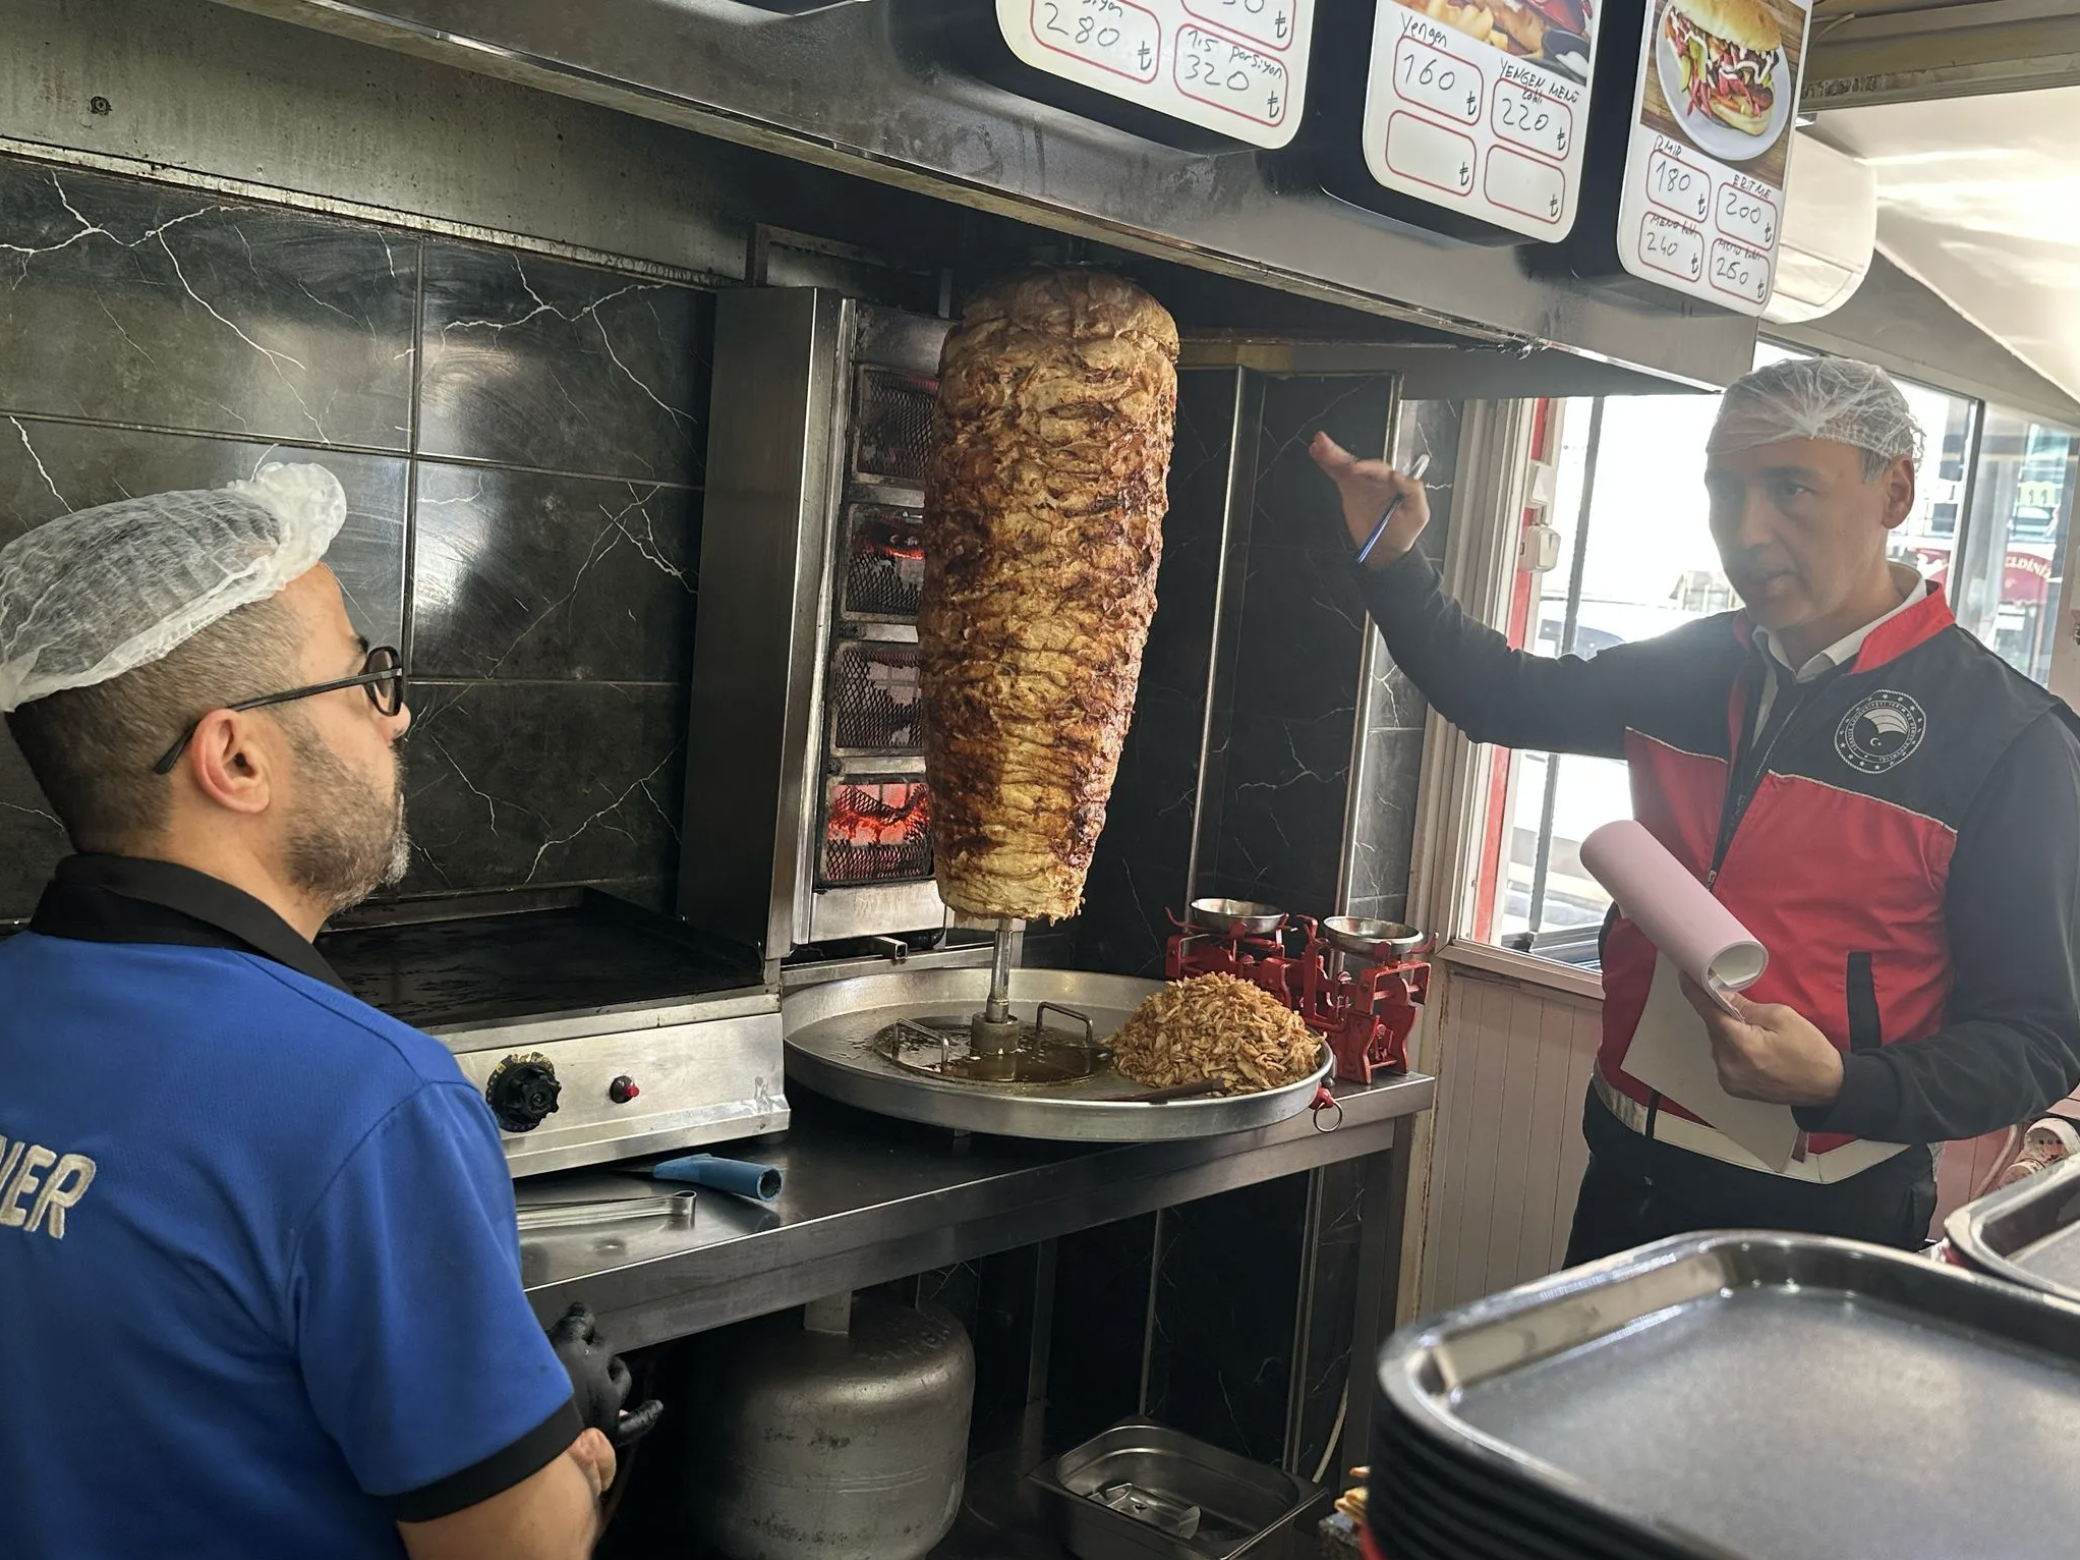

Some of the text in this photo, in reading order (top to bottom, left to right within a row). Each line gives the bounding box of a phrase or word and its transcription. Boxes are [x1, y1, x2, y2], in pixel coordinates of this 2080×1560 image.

[1044, 2, 1120, 47] 280
[1184, 54, 1250, 91] 320
[1402, 54, 1455, 91] 160
[1501, 98, 1549, 131] 220
[1655, 160, 1691, 192] 180
[1725, 192, 1762, 224] 200
[1646, 232, 1679, 257] 240
